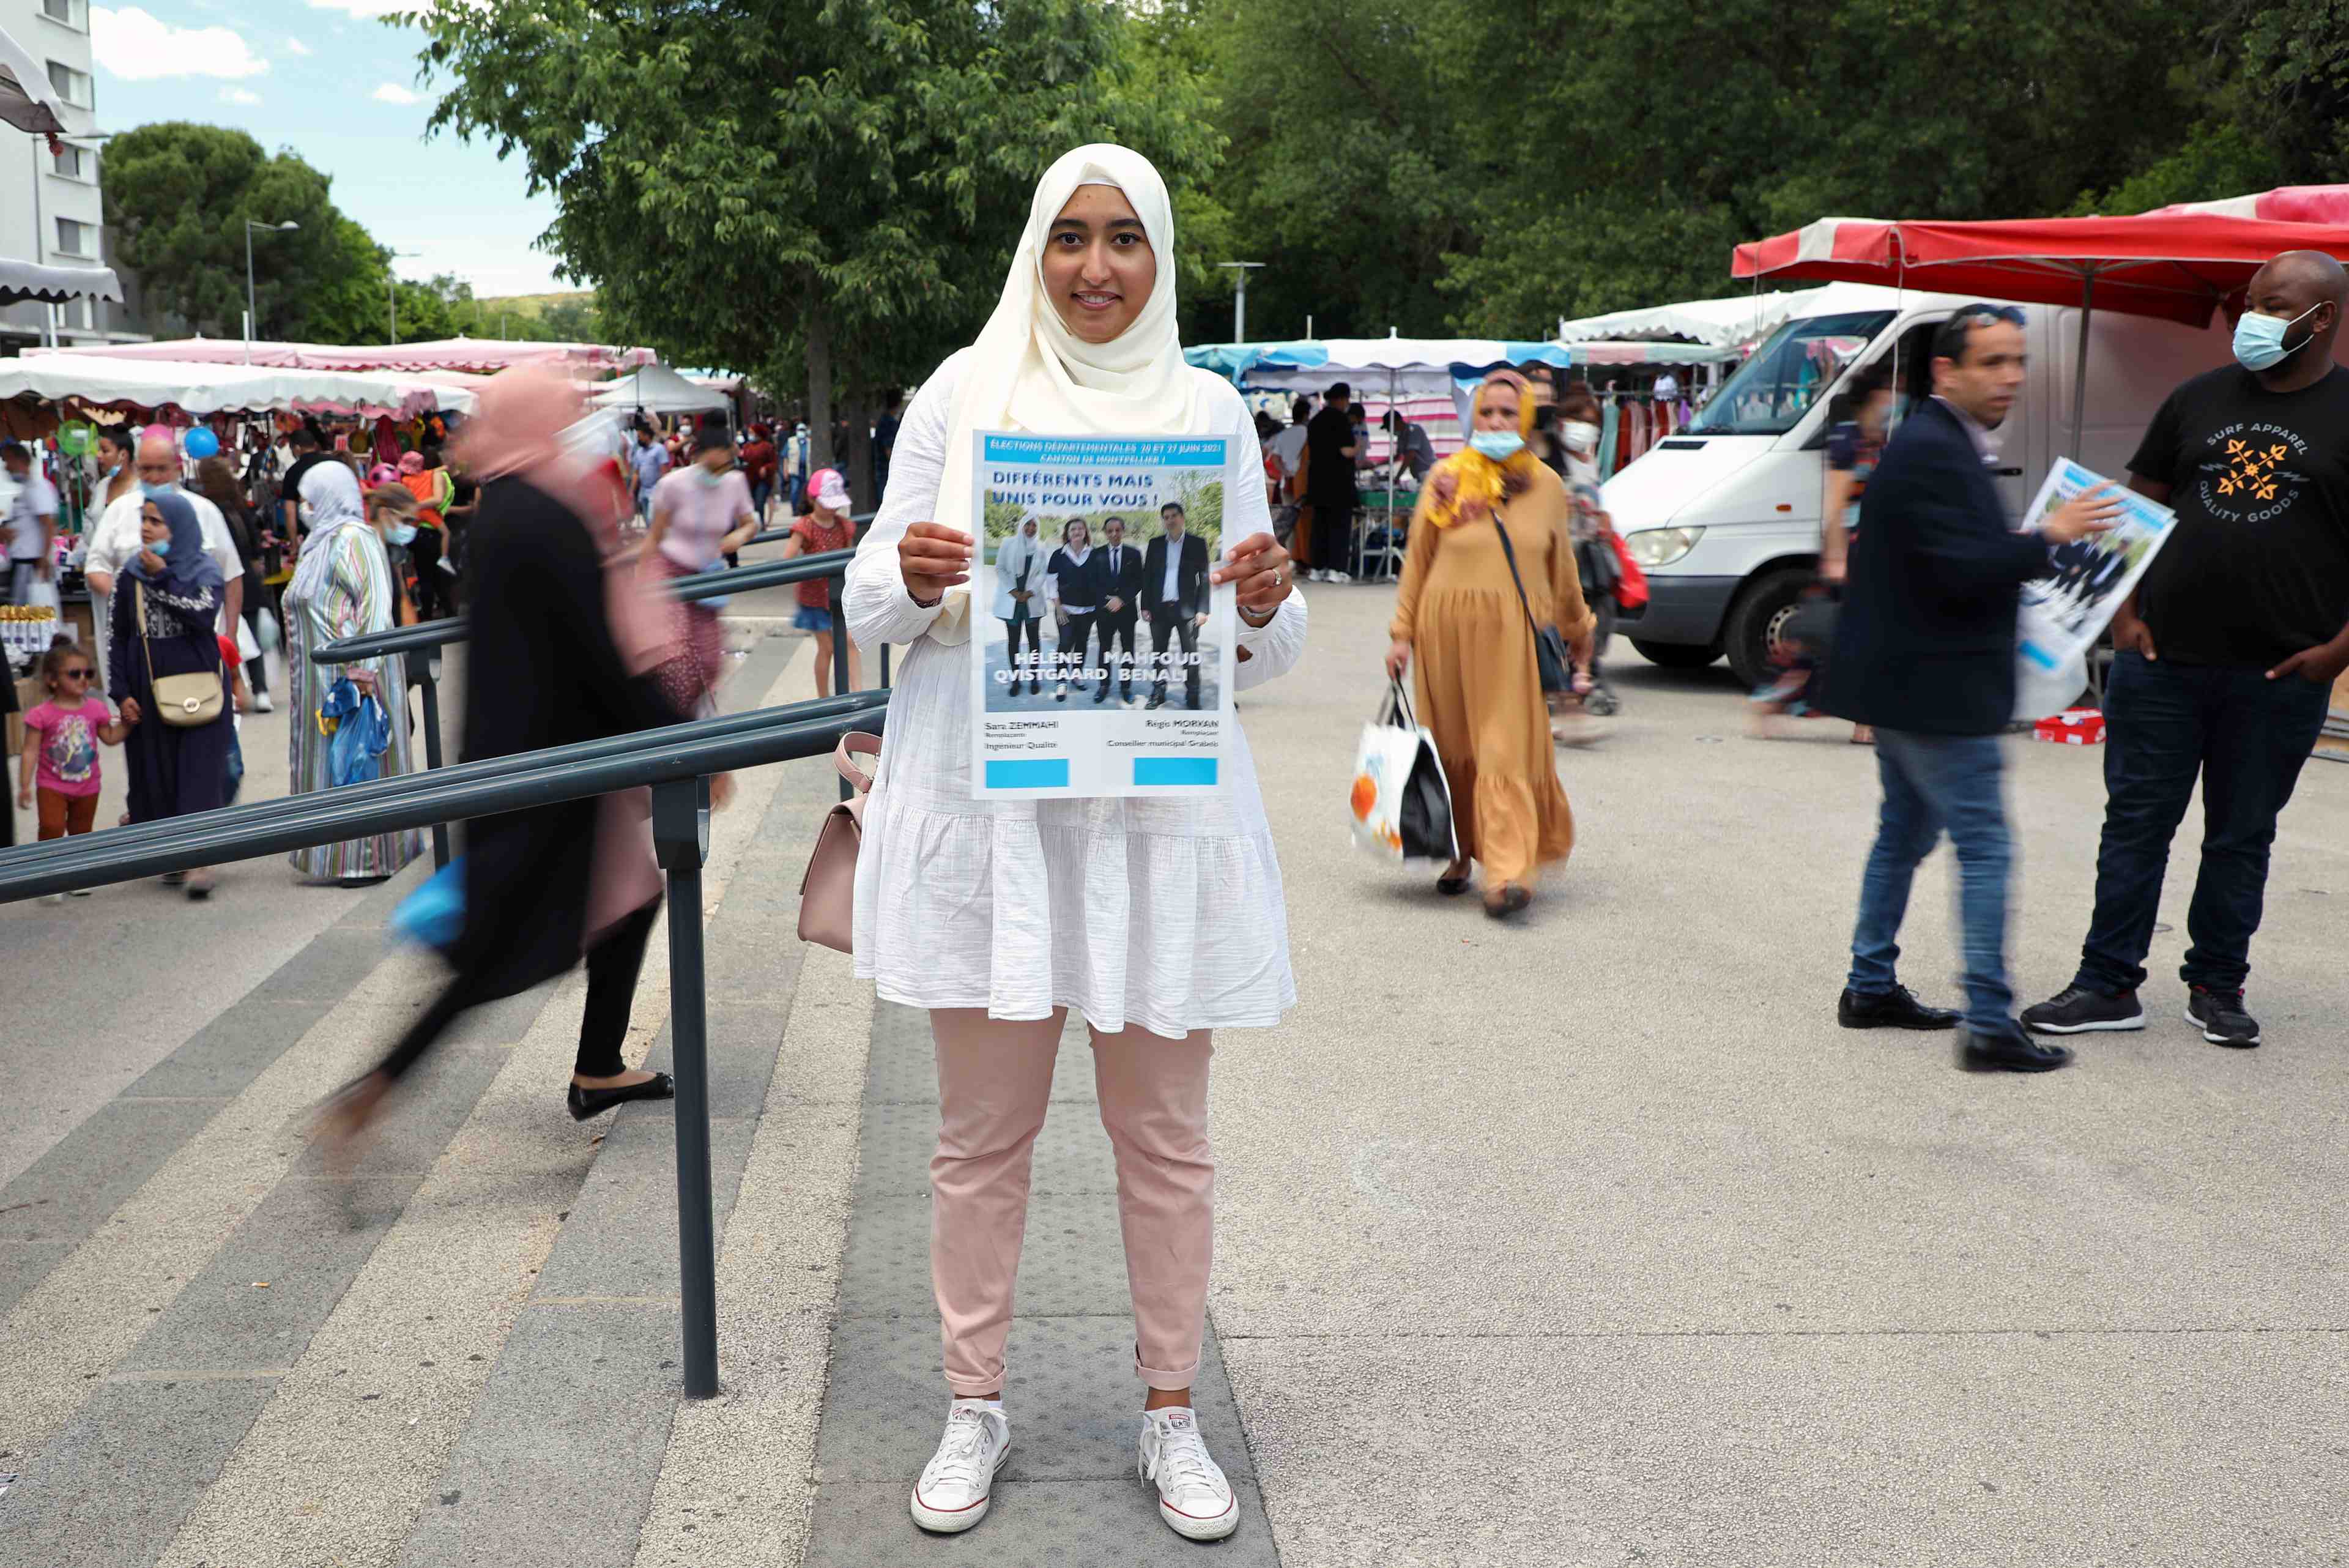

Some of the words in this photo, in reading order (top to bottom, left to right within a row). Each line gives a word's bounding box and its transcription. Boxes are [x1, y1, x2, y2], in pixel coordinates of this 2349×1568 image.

[990, 438, 1042, 451] ÉLECTIONS
[1153, 444, 1165, 453] ET
[1167, 444, 1177, 453] 27
[1178, 444, 1201, 454] JUIN
[1201, 444, 1222, 453] 2021
[2206, 423, 2244, 446] SURF
[2250, 423, 2309, 456] APPAREL
[1040, 453, 1081, 464] CANTON
[1082, 455, 1094, 464] DE
[1096, 455, 1159, 465] MONTPELLIER
[993, 470, 1102, 487] DIFFÉRENTS
[1108, 474, 1154, 487] MAIS
[992, 491, 1036, 505] UNIS
[1042, 493, 1093, 507] POUR
[1099, 493, 1148, 507] VOUS
[2200, 480, 2241, 522] QUALITY
[2247, 489, 2299, 522] GOODS
[1014, 649, 1083, 665] HÉLÈNE
[1104, 651, 1204, 666] MAHFOUD
[993, 668, 1108, 684] QVISTGAARD
[1118, 668, 1187, 683] BENALI
[1008, 721, 1059, 729] ZEMMAHI
